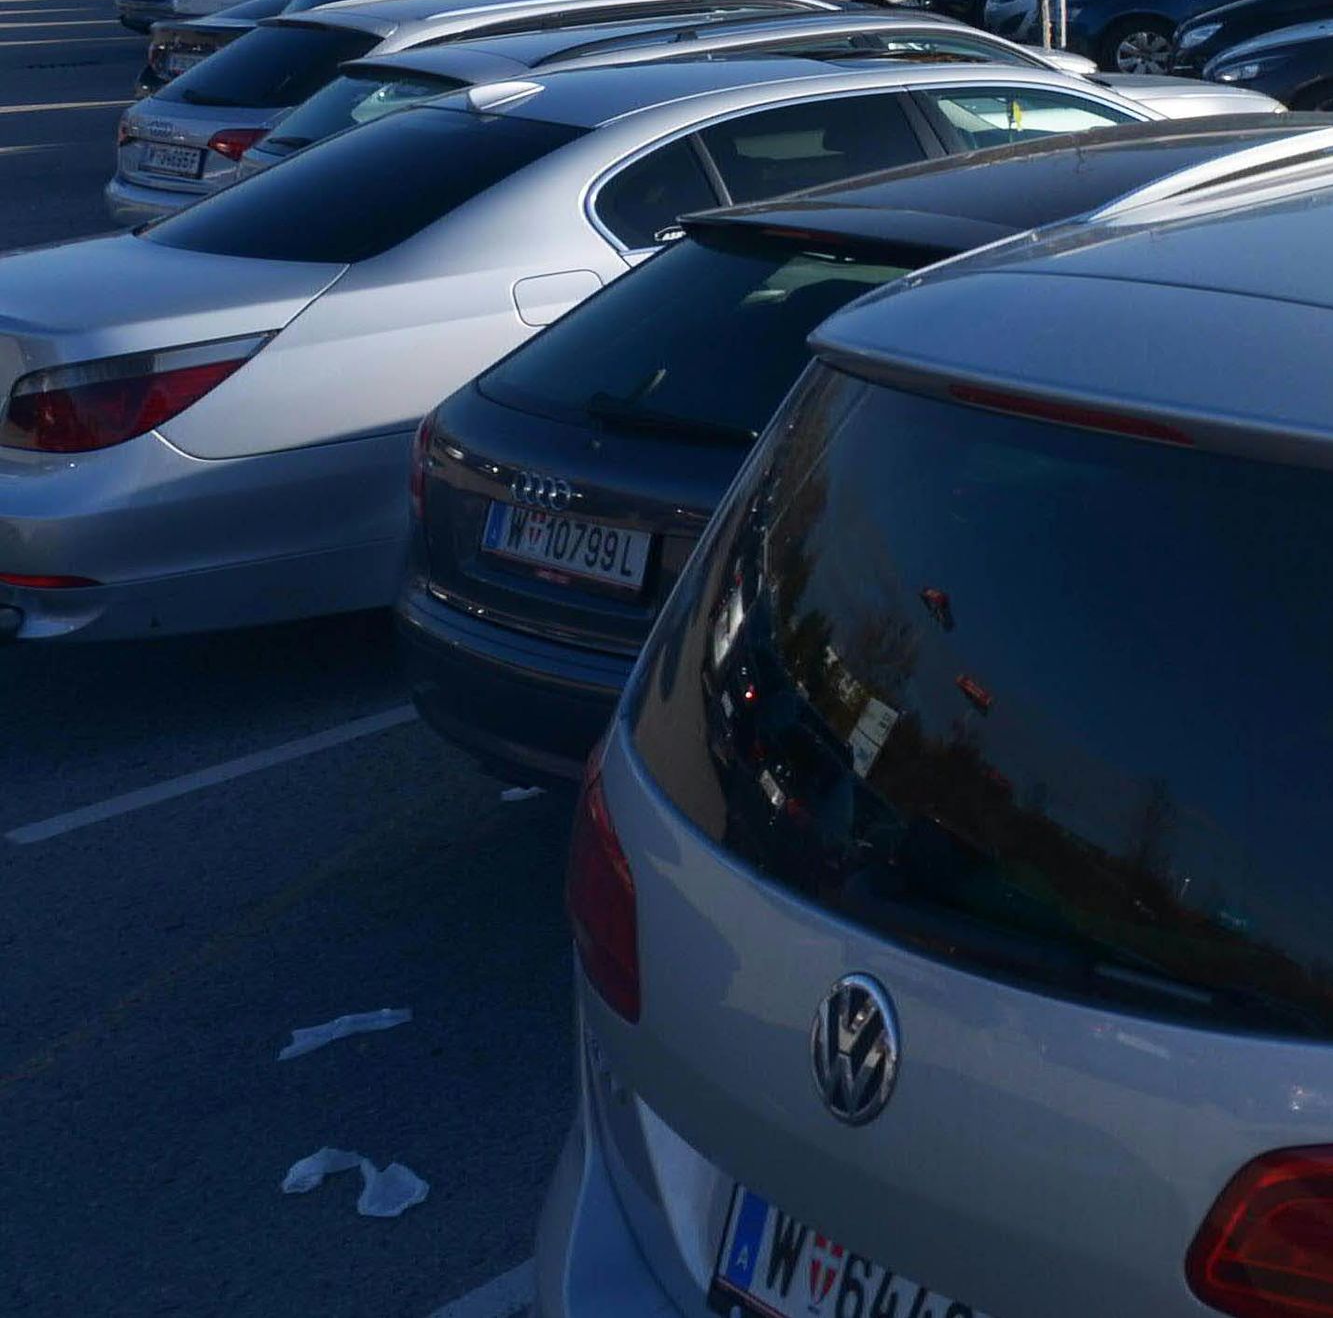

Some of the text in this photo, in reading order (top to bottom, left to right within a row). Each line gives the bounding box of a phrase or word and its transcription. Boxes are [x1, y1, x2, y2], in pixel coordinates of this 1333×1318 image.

[507, 508, 632, 577] W 10799L
[766, 1209, 809, 1299] W
